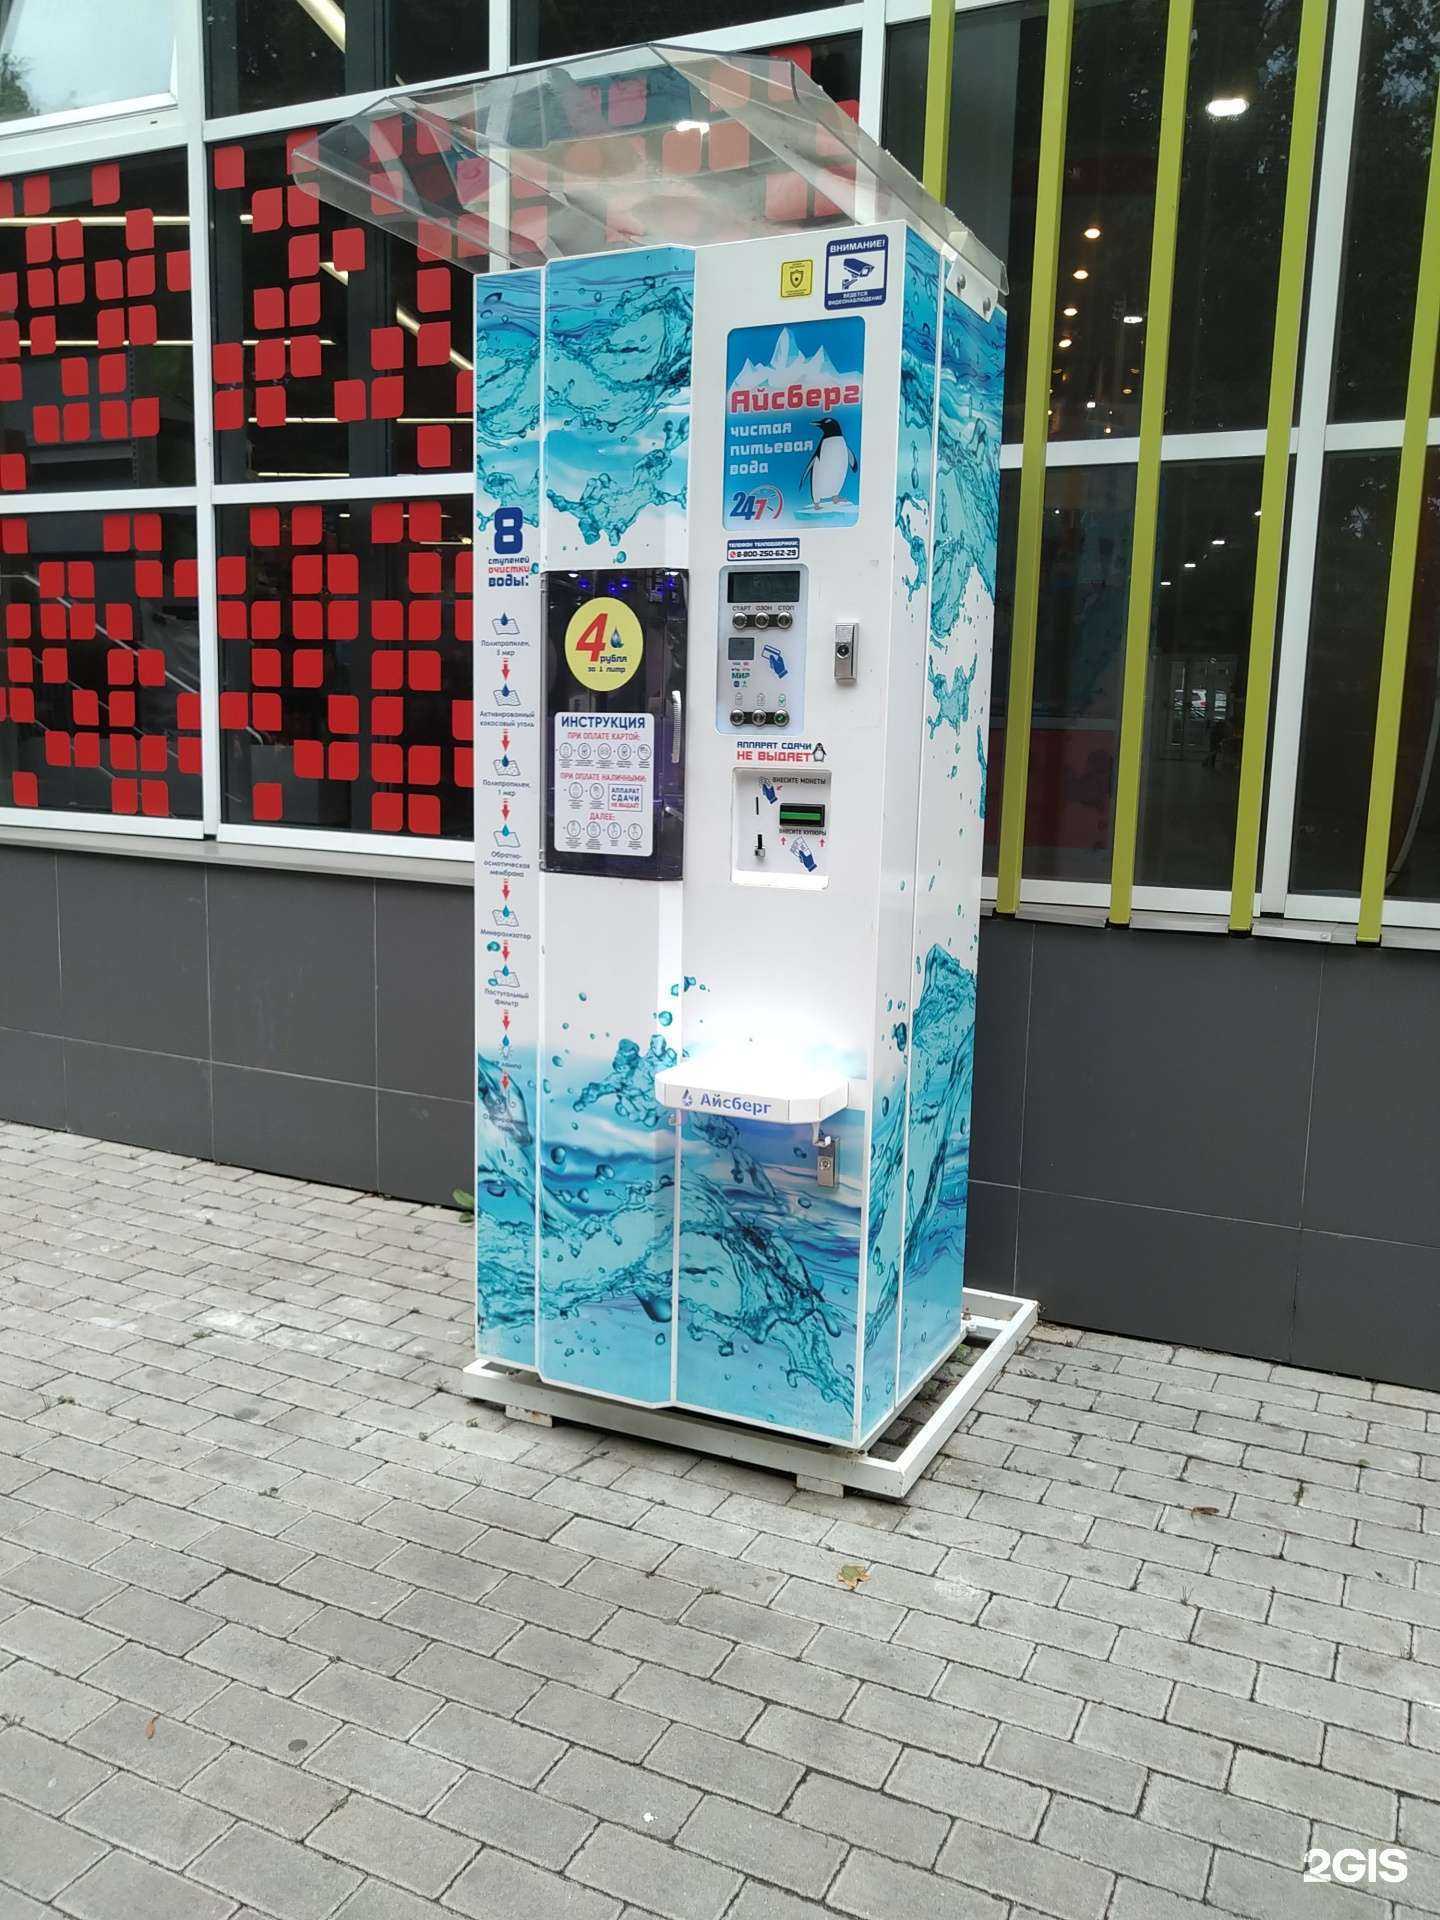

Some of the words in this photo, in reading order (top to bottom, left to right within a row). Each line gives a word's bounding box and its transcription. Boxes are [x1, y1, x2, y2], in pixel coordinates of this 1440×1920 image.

[830, 239, 886, 253] ВНИМАНИЕ!
[731, 384, 861, 413] Айсберг
[730, 422, 792, 437] чистая
[730, 440, 814, 456] питьевая
[730, 460, 769, 475] вода
[494, 507, 523, 554] 8
[488, 556, 530, 566] ступеней
[488, 566, 530, 574] очистки
[488, 574, 529, 587] воды:
[576, 613, 608, 662] 4
[600, 654, 628, 663] рубля
[480, 710, 535, 719] Активированный
[561, 716, 646, 730] ИНСТРУКЦИЯ
[583, 732, 609, 740] ОПЛАТЕ
[737, 741, 778, 749] АППАРАТ
[781, 742, 812, 750] СДАЧИ
[737, 751, 752, 760] НЕ
[758, 751, 811, 762] ВЫДАЕТ
[772, 776, 799, 784] ВНЕСИТЕ
[800, 777, 826, 785] МОНЕТЫ
[611, 794, 640, 802] СДАЧИ
[700, 1093, 772, 1116] Айсберг
